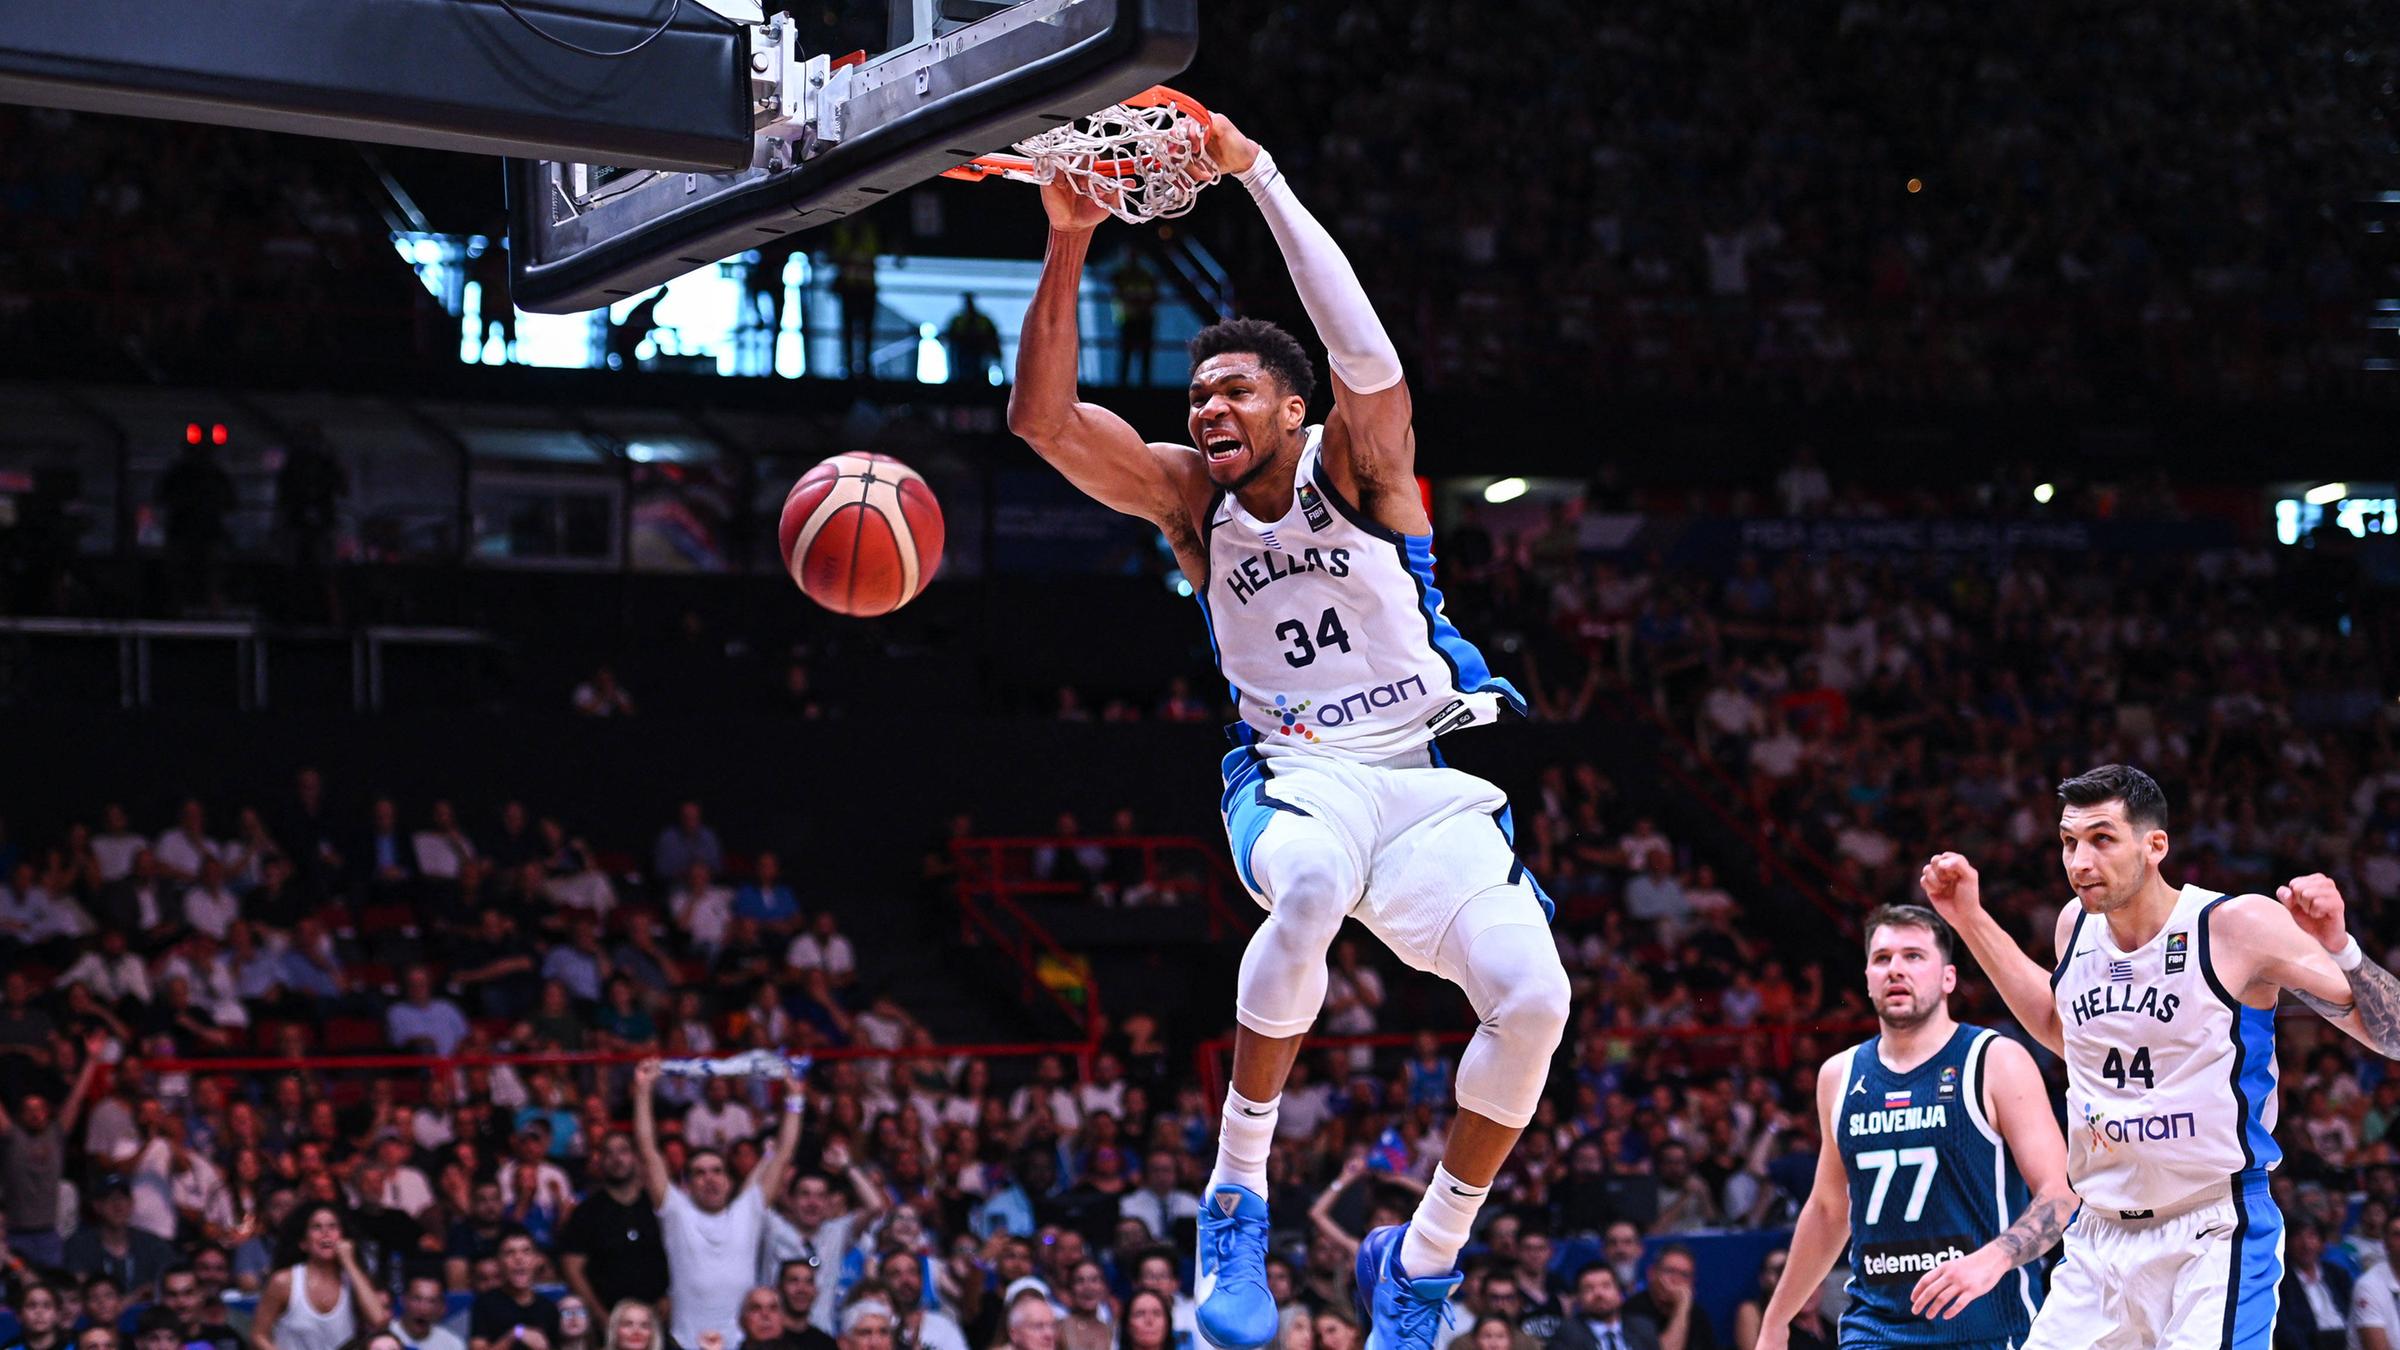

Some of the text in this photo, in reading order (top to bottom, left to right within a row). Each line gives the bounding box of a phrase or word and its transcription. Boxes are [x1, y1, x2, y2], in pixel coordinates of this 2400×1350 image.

[1308, 506, 1325, 521] FIBA
[1226, 548, 1351, 605] HELLAS
[1275, 607, 1352, 669] 34
[2168, 954, 2184, 964] FIBA
[2072, 984, 2181, 1027] HELLAS
[2102, 1046, 2155, 1090] 44
[1849, 1104, 1947, 1137] SLOVENIJA
[1855, 1146, 1939, 1225] 77
